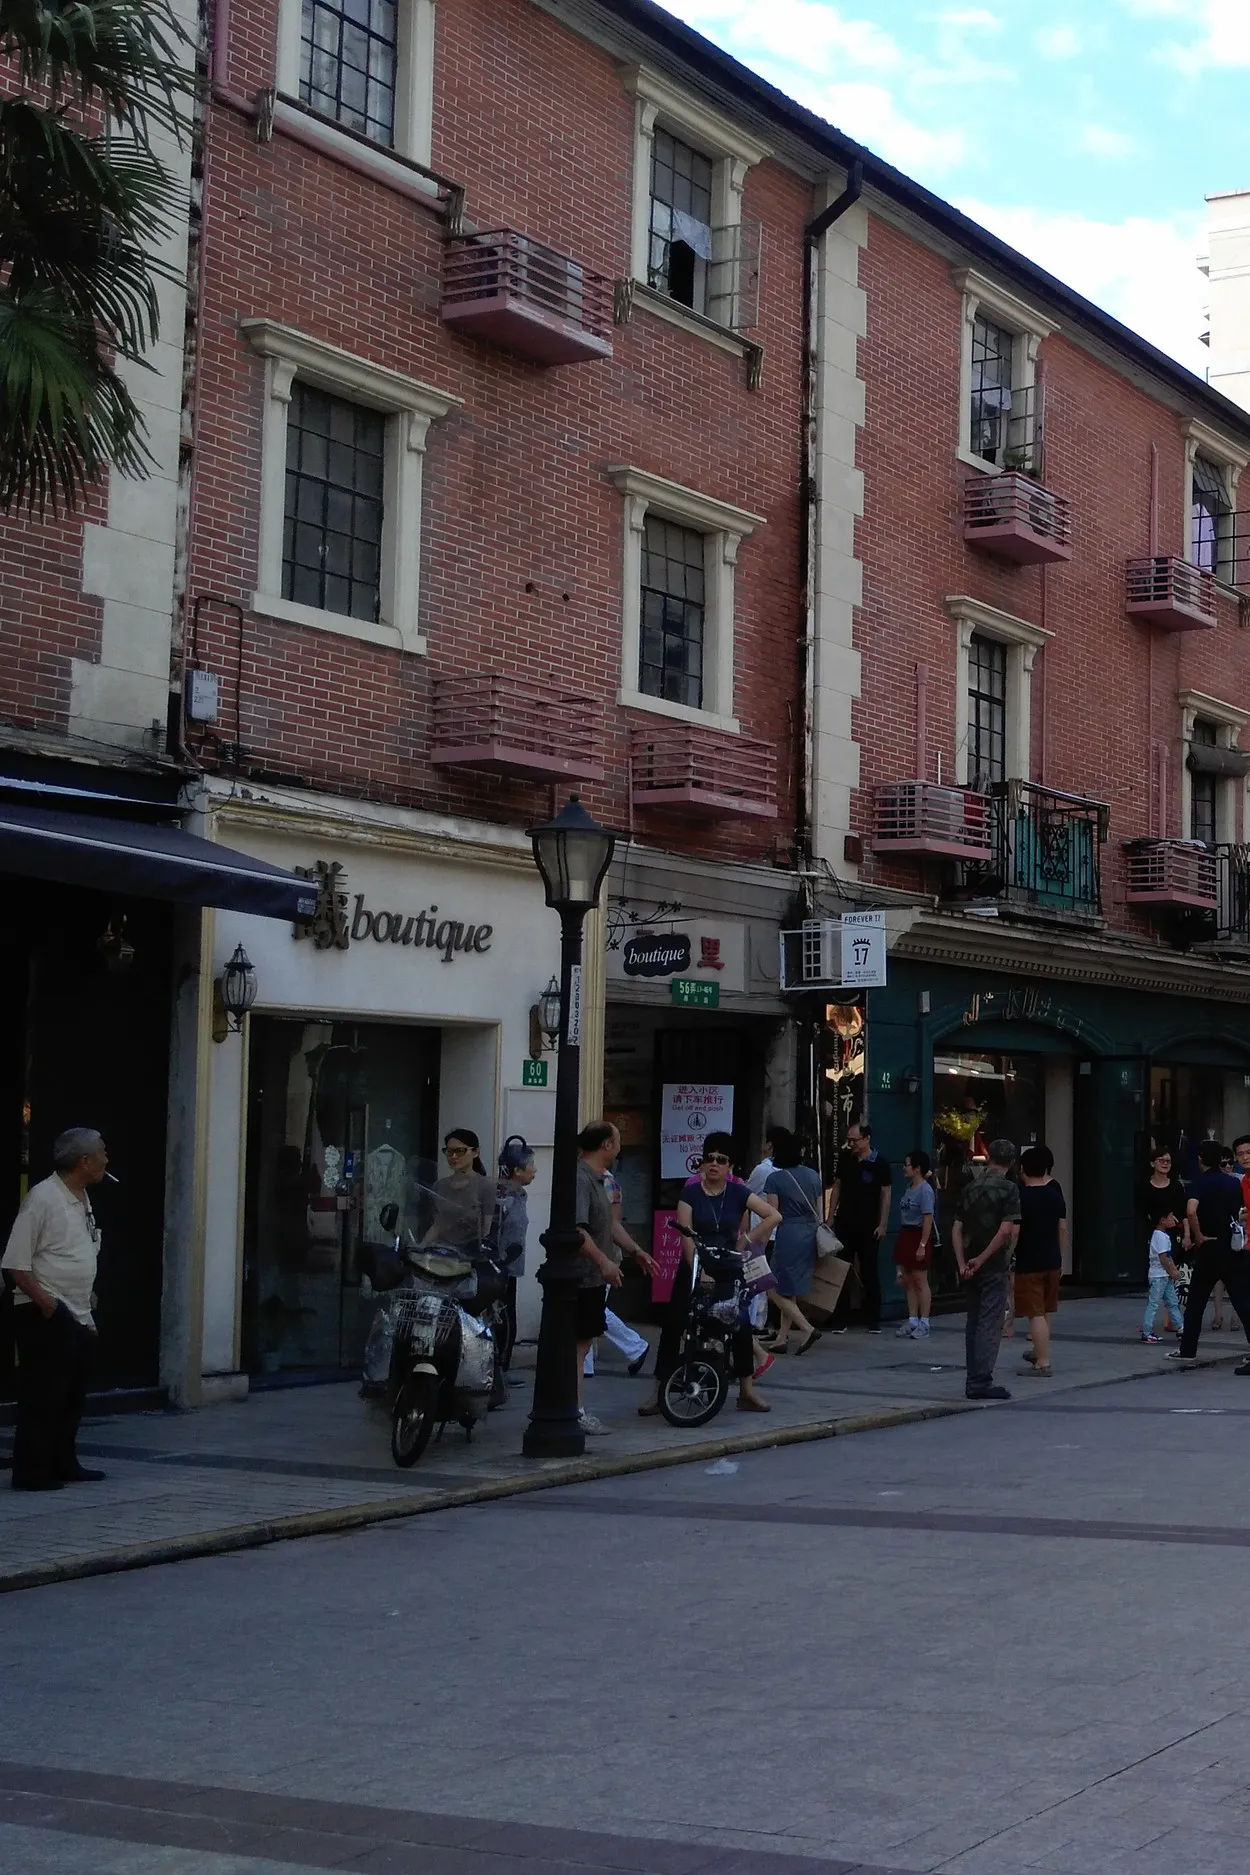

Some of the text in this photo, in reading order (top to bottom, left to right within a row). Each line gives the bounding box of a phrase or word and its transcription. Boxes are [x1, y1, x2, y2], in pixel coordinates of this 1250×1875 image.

[844, 915, 873, 924] FOREVER
[351, 894, 494, 963] boutique
[629, 947, 685, 966] boutique
[854, 948, 869, 966] 17
[529, 1062, 542, 1076] 60
[882, 1072, 891, 1084] 42
[678, 1085, 719, 1095] 进入小区
[672, 1095, 724, 1105] 请下车推行
[679, 1143, 689, 1153] No
